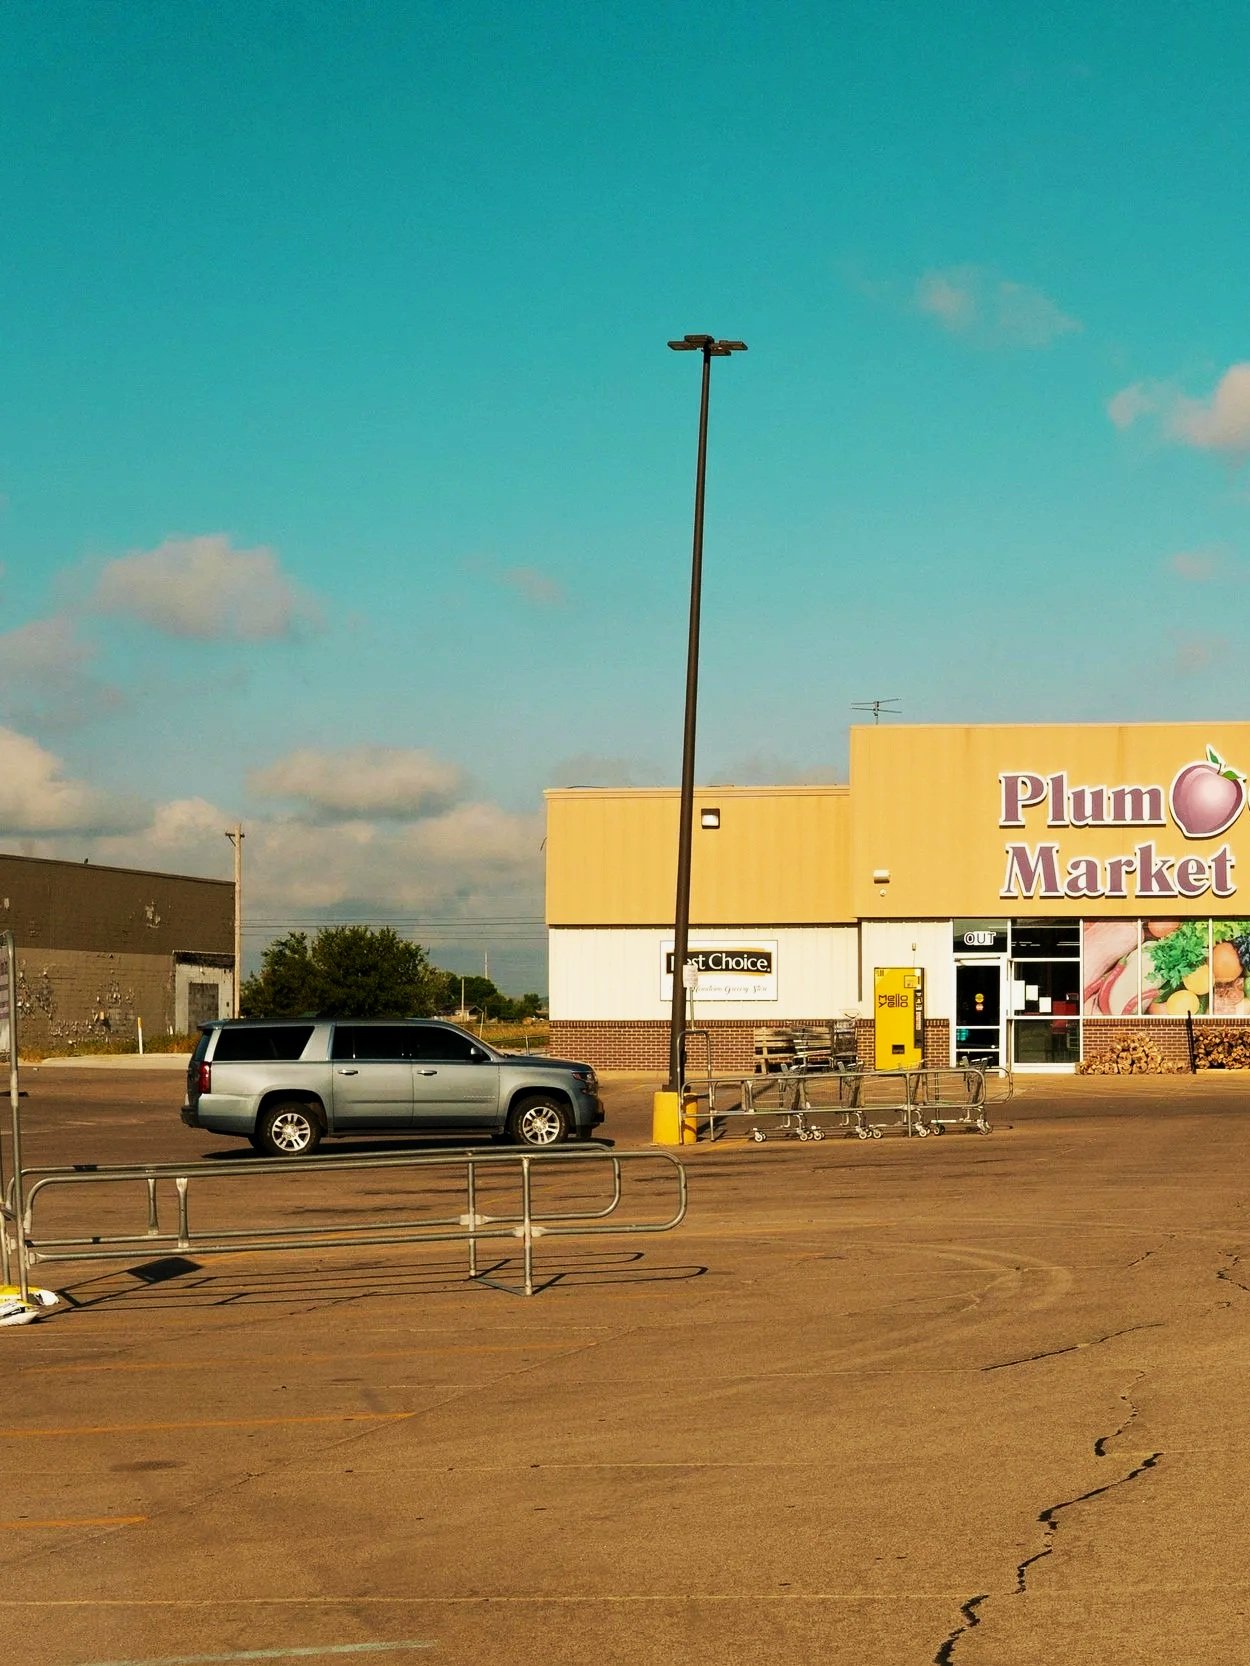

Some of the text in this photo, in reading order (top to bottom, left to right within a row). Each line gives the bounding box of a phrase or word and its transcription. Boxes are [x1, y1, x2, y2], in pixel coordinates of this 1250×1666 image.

[999, 771, 1166, 826] Plum
[1000, 842, 1237, 899] Market
[963, 930, 997, 946] OUT
[878, 993, 909, 1001] Mello
